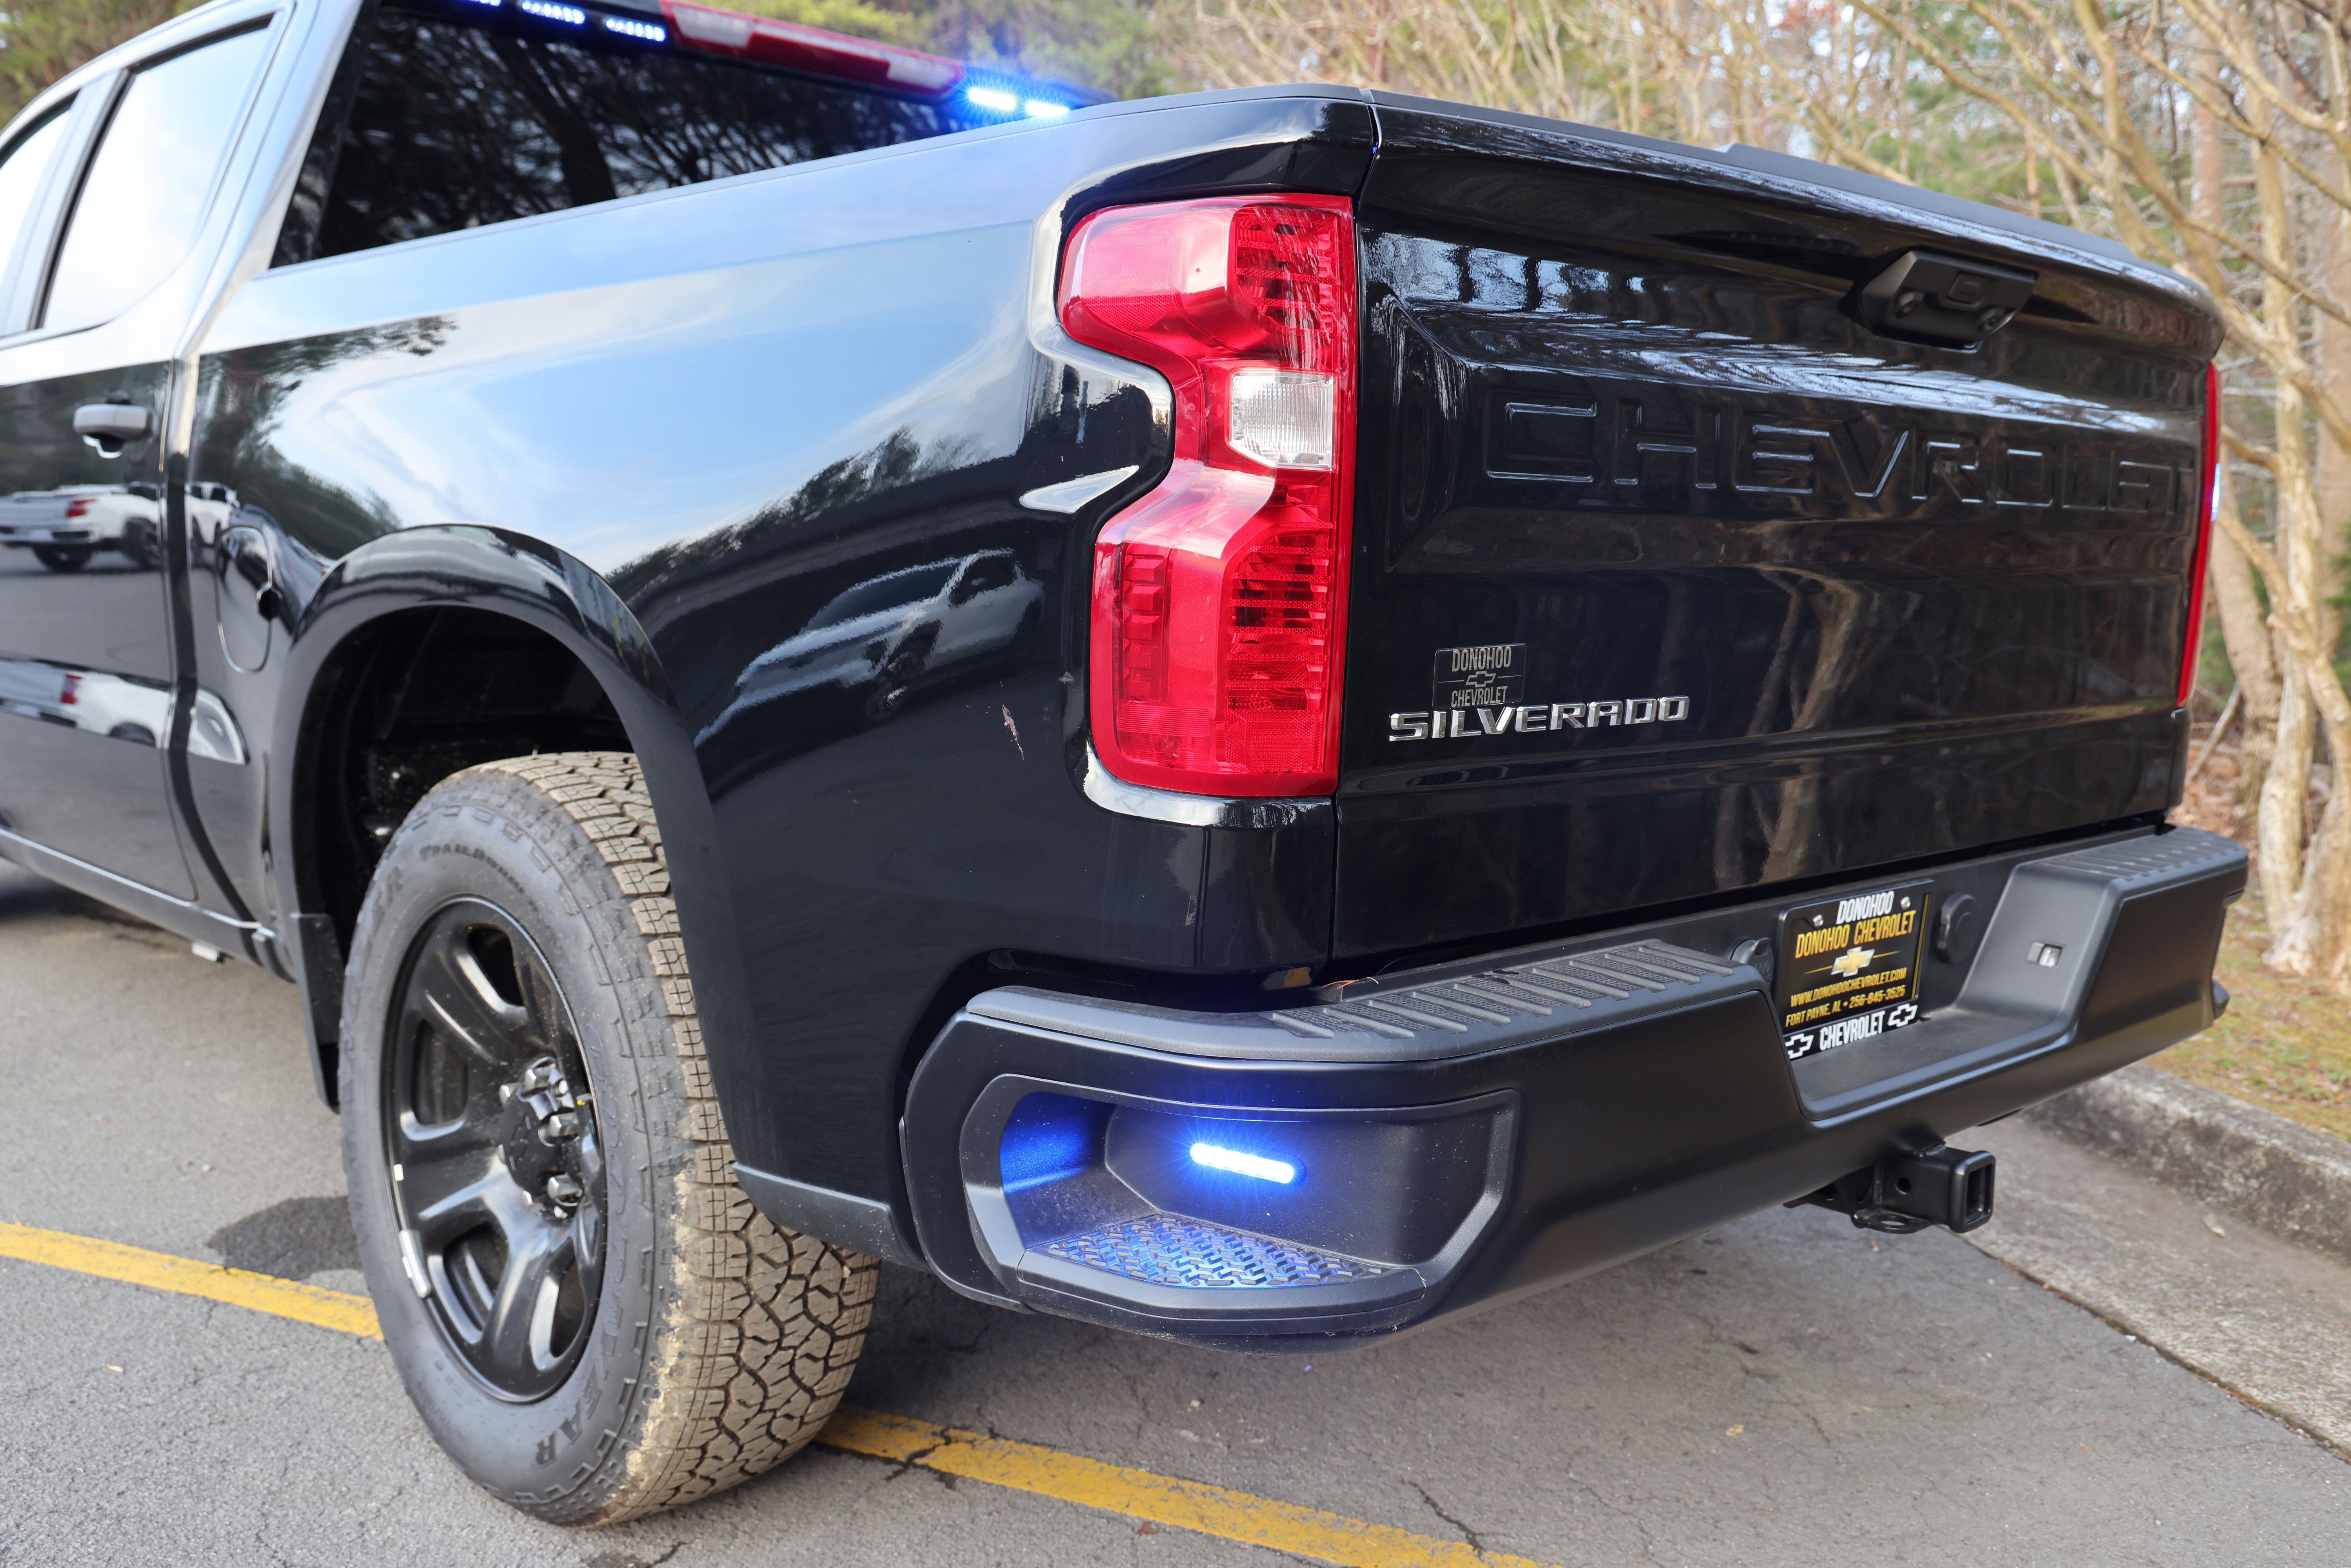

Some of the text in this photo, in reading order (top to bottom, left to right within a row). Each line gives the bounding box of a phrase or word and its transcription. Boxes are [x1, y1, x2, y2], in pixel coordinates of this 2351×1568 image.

[1482, 388, 2195, 515] CHEVROLET
[1451, 646, 1512, 672] DONOHOO
[1451, 686, 1508, 708] CHEVROLET
[1389, 695, 1690, 742] SILVERADO
[1836, 891, 1895, 924] DONOHOO
[1795, 910, 1917, 959] DONOHOO CHEVROLET
[1785, 984, 1906, 1027] FORT PAYNE, AL 256-845-3525
[1790, 967, 1907, 1007] WWW.DONOHOOCHEVROLET.COM
[1819, 1010, 1886, 1051] CHEVROLET
